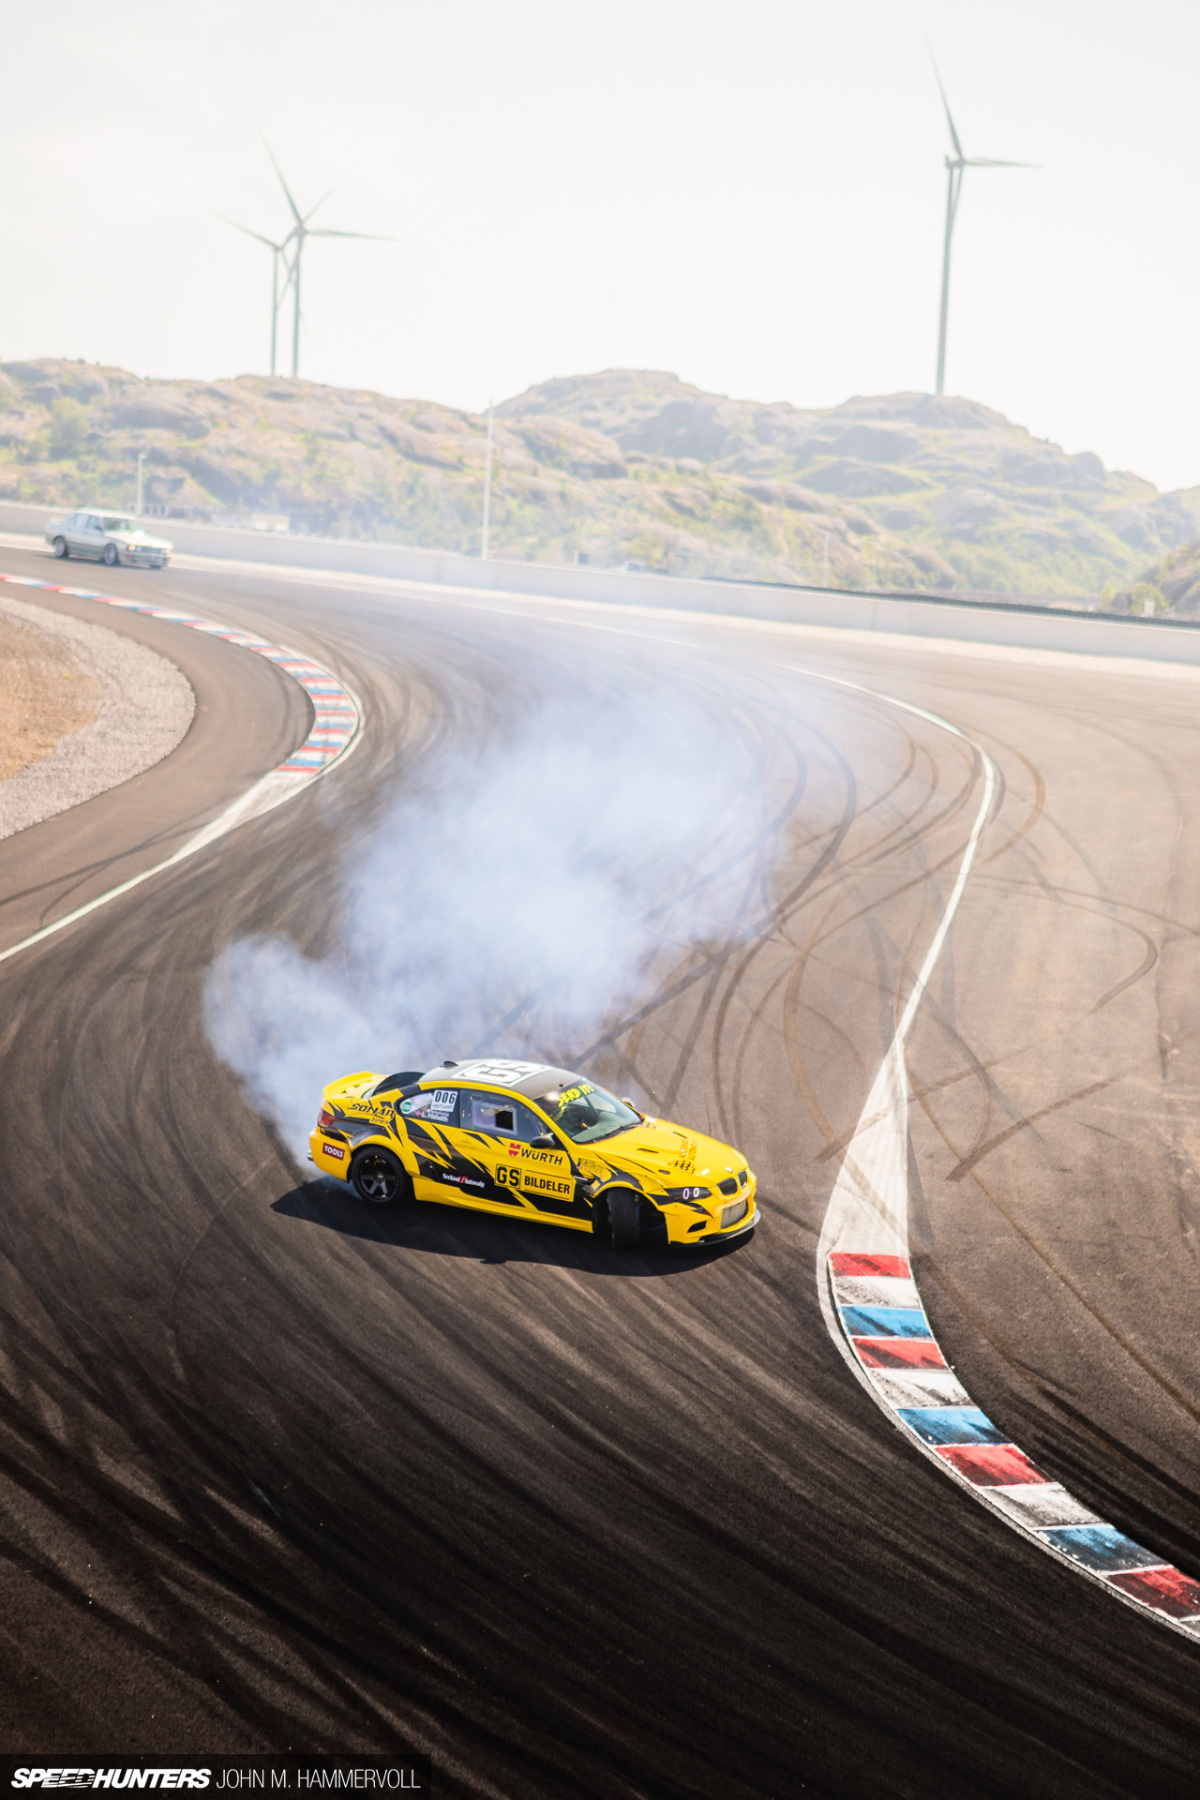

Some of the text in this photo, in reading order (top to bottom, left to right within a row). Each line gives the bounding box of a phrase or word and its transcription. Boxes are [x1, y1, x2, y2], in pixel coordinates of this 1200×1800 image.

[435, 1091, 456, 1104] 006
[557, 1088, 581, 1107] SEND
[347, 1102, 395, 1118] SONAR
[371, 1117, 390, 1125] tires
[324, 1144, 344, 1158] TOOLS
[521, 1147, 563, 1165] WÜRTH
[496, 1166, 570, 1195] GS BILDELER
